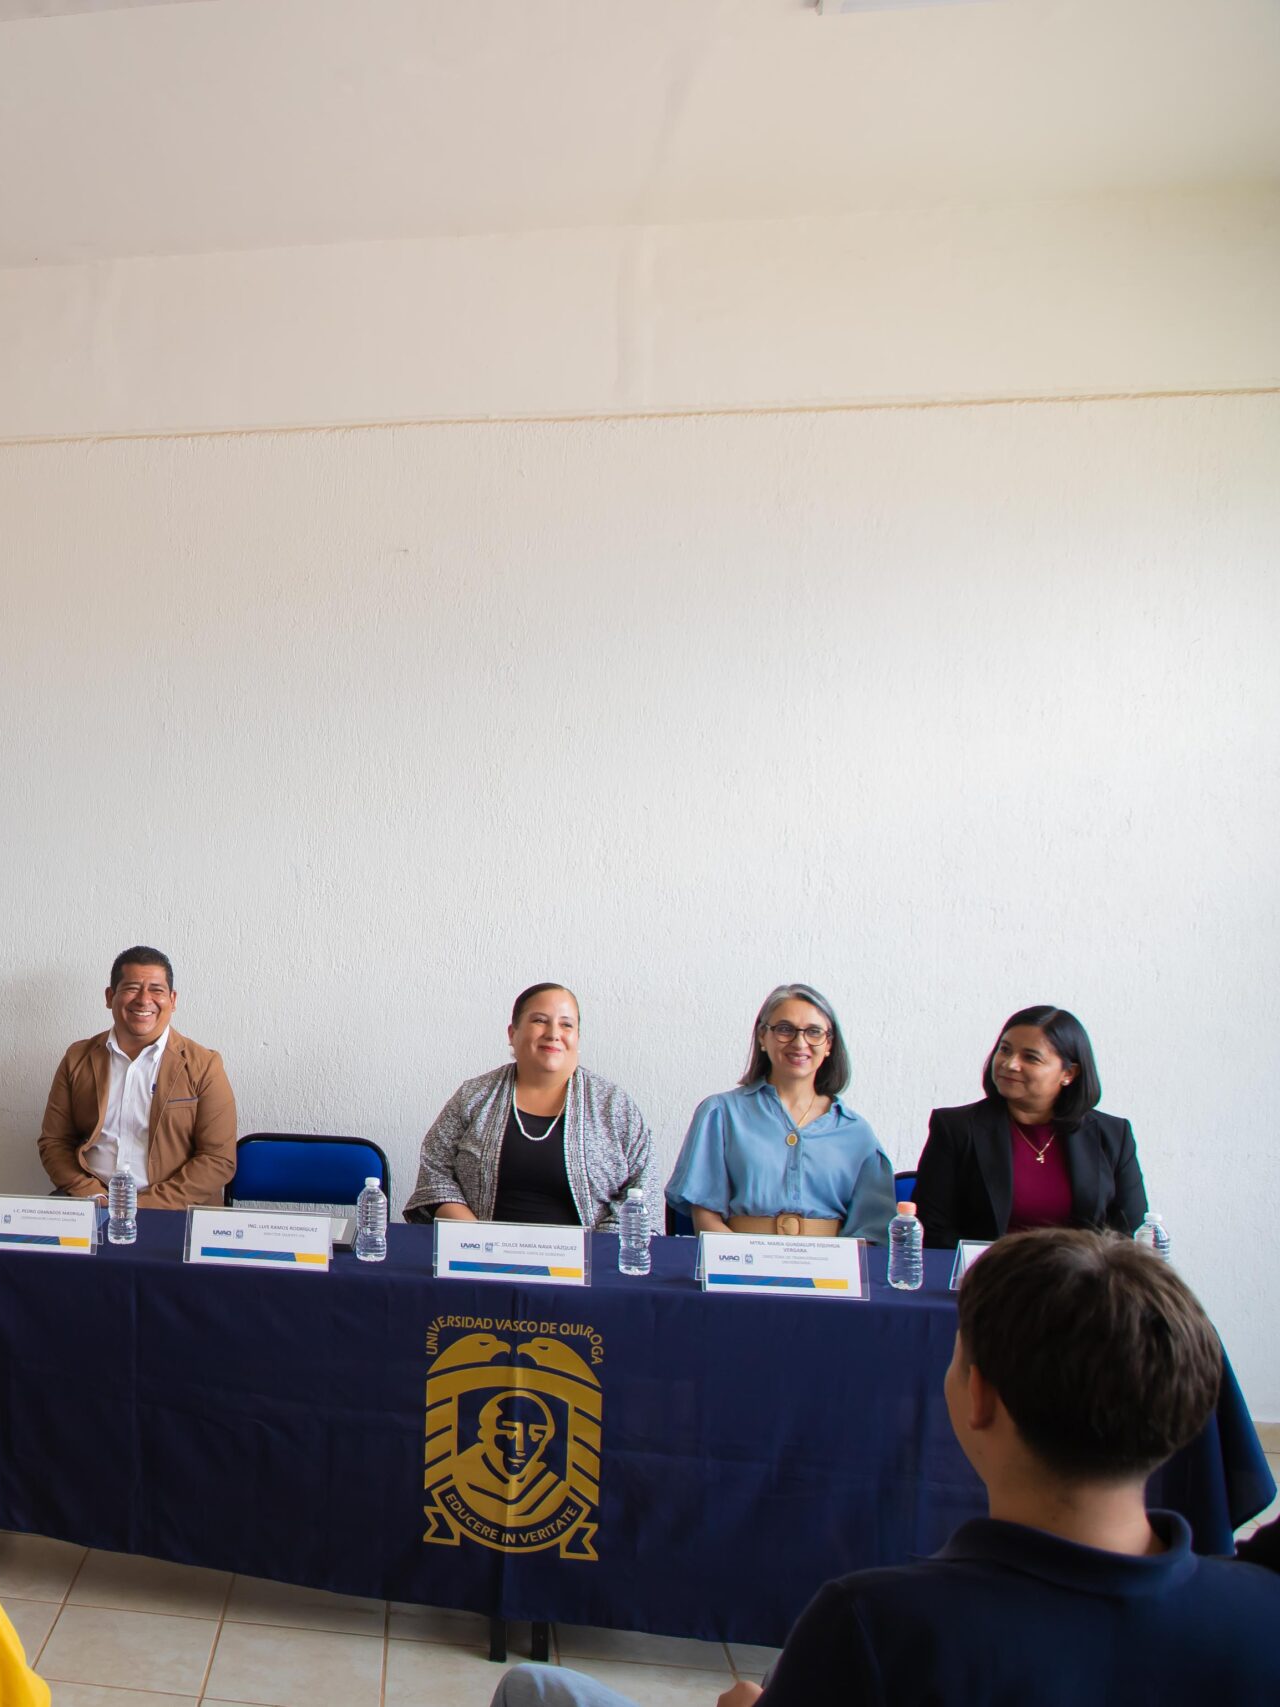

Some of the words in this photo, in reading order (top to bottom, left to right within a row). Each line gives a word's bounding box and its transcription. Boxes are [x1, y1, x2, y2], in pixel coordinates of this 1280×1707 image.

[426, 1315, 493, 1355] UNIVERSIDAD
[495, 1319, 538, 1333] VASCO
[540, 1322, 557, 1334] DE
[559, 1323, 604, 1365] QUIROGA
[445, 1493, 499, 1540] EDUCERE
[501, 1533, 516, 1544] IN
[519, 1506, 578, 1544] VERITATE
